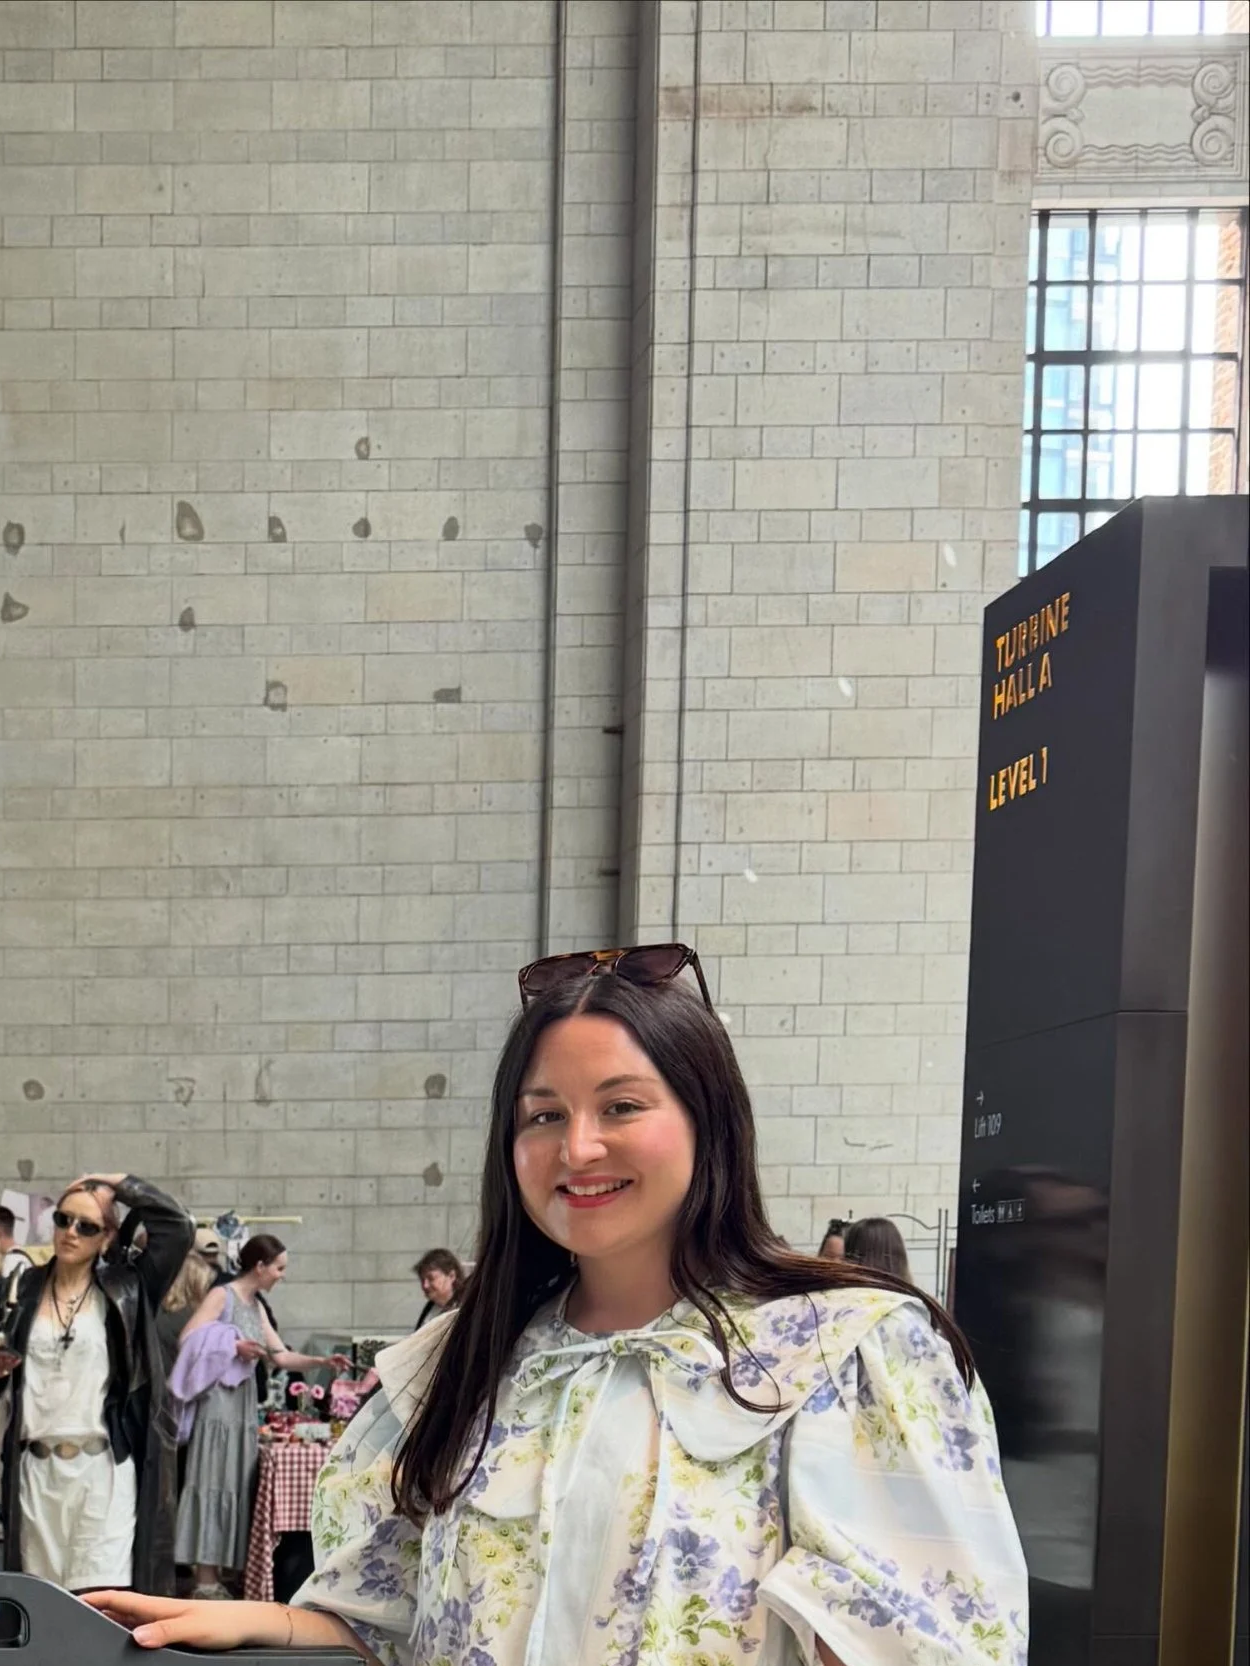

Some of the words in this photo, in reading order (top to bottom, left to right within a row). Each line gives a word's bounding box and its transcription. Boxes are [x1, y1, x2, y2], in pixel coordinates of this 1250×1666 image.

[995, 592, 1070, 672] TURBINE
[992, 662, 1035, 720] HALL
[1039, 652, 1053, 693] A
[989, 753, 1037, 811] LEVEL
[1041, 746, 1048, 784] 1
[974, 1115, 987, 1139] Lift
[987, 1112, 1002, 1136] 109
[971, 1203, 996, 1224] Toilets
